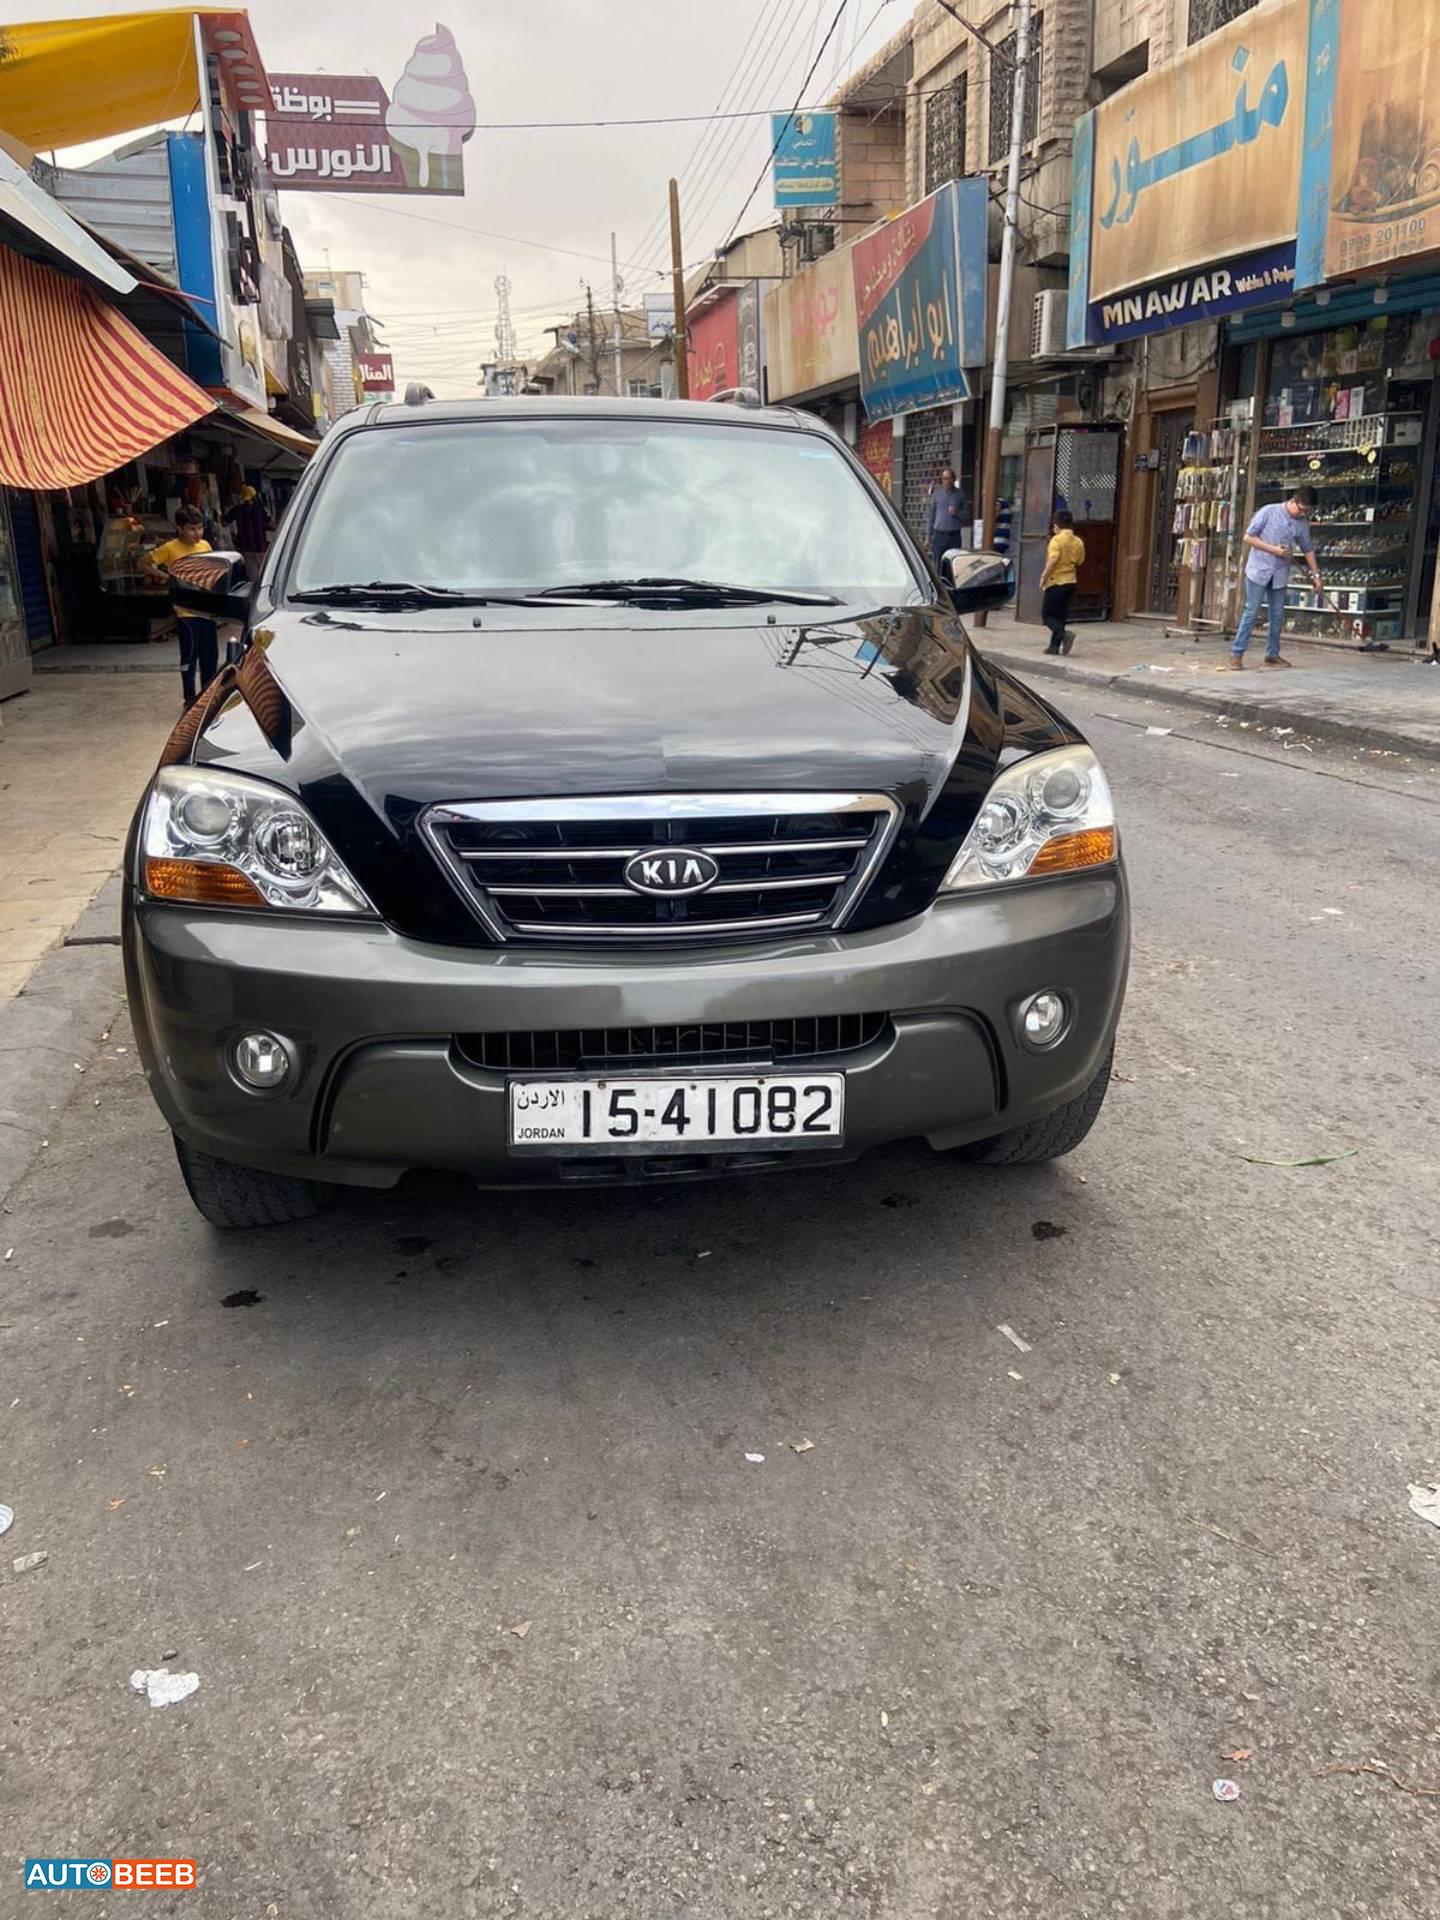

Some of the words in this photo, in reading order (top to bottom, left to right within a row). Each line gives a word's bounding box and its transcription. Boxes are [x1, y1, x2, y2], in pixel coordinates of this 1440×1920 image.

[271, 144, 391, 177] النورس
[1376, 218, 1426, 246] 201100
[928, 268, 953, 360] ابو
[1103, 270, 1232, 329] MNAWAR
[867, 279, 925, 383] ابراهيم
[641, 859, 704, 884] KIA
[517, 1089, 565, 1110] الاردن
[583, 1085, 832, 1137] 15-41082
[518, 1127, 565, 1139] JORDAN
